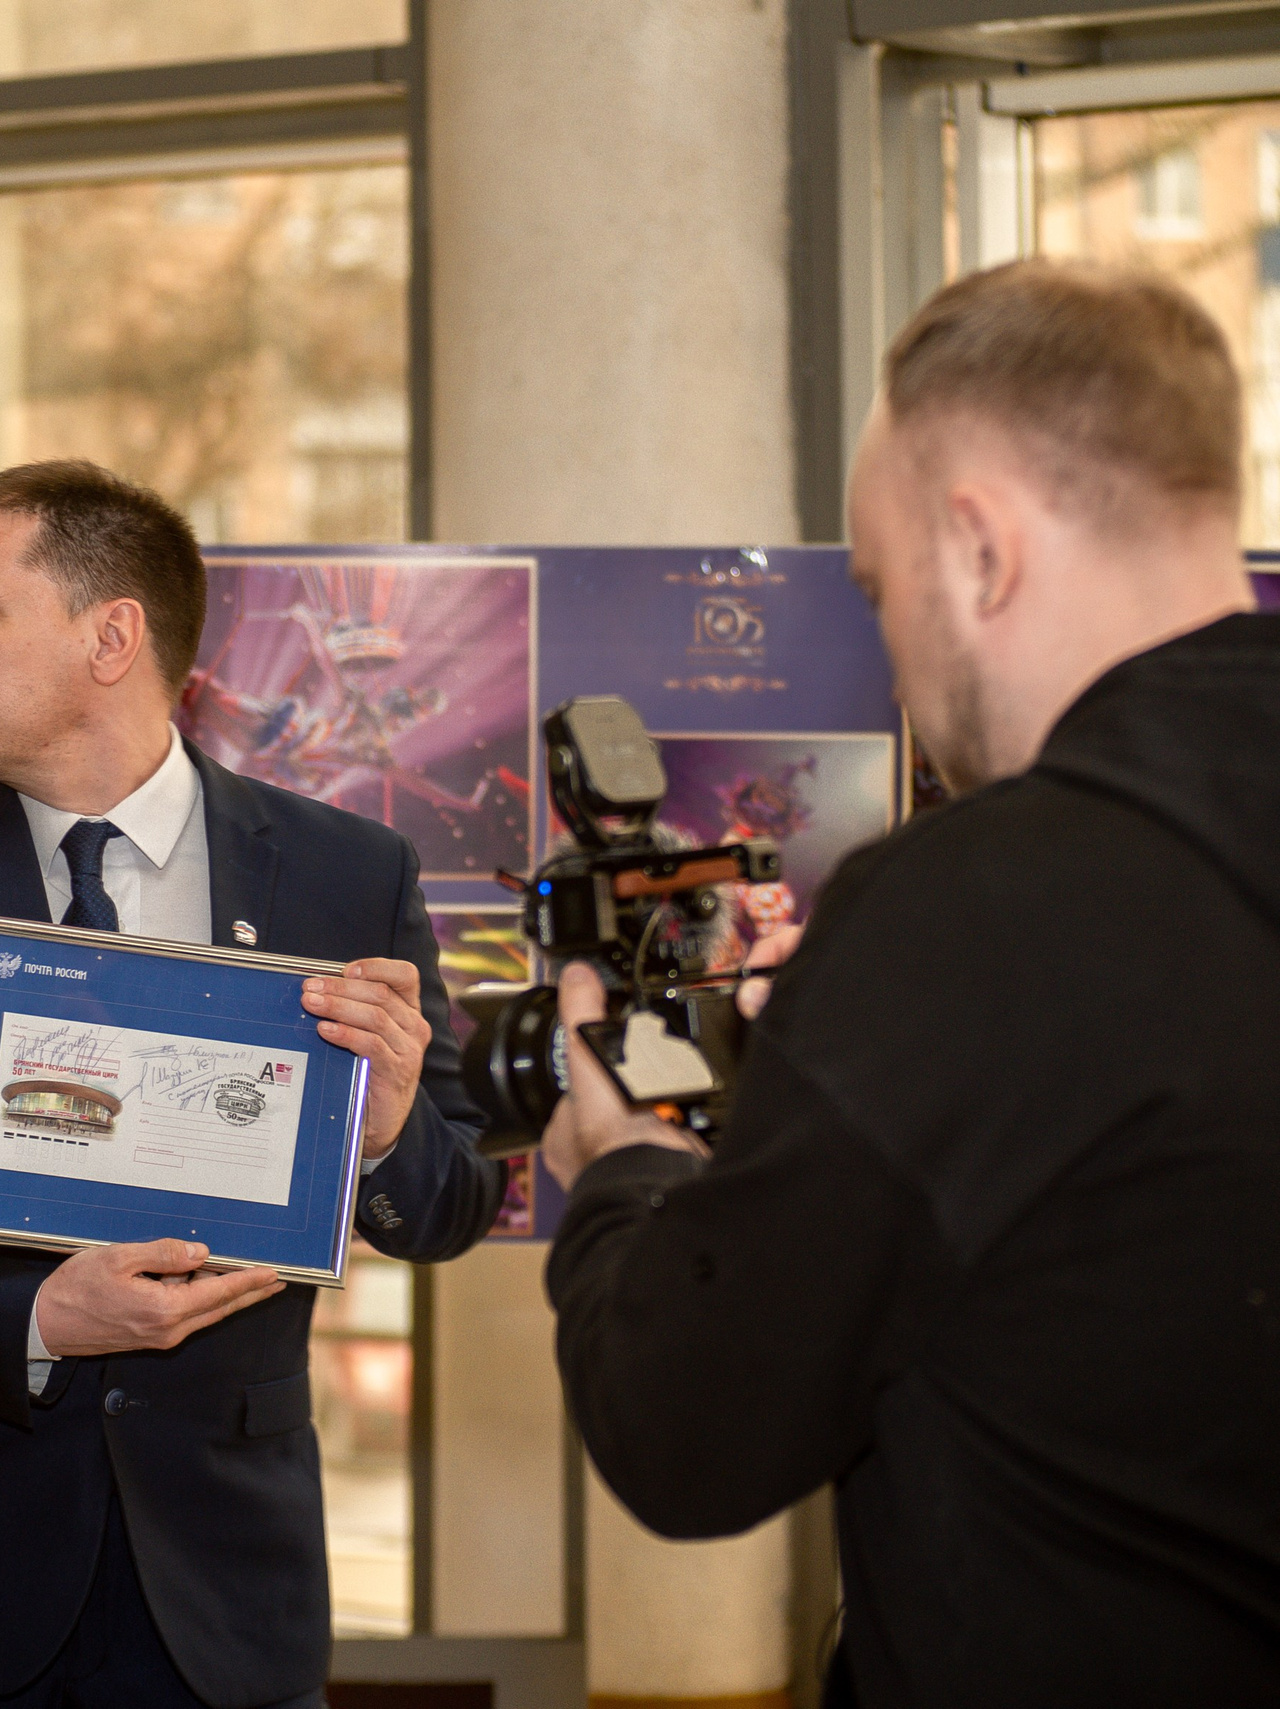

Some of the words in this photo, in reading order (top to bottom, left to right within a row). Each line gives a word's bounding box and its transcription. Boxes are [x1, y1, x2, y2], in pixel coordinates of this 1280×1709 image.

[24, 963, 52, 976] ПОЧТА
[55, 967, 87, 980] РОССИИ
[12, 1067, 22, 1076] 50
[102, 1071, 119, 1079] ЦИРК
[230, 1079, 256, 1088] БРЯНСКИЙ
[218, 1084, 265, 1098] ГОСУДАРСТВЕННЫЙ
[231, 1101, 248, 1109] ЦИРК
[227, 1111, 237, 1120] 50
